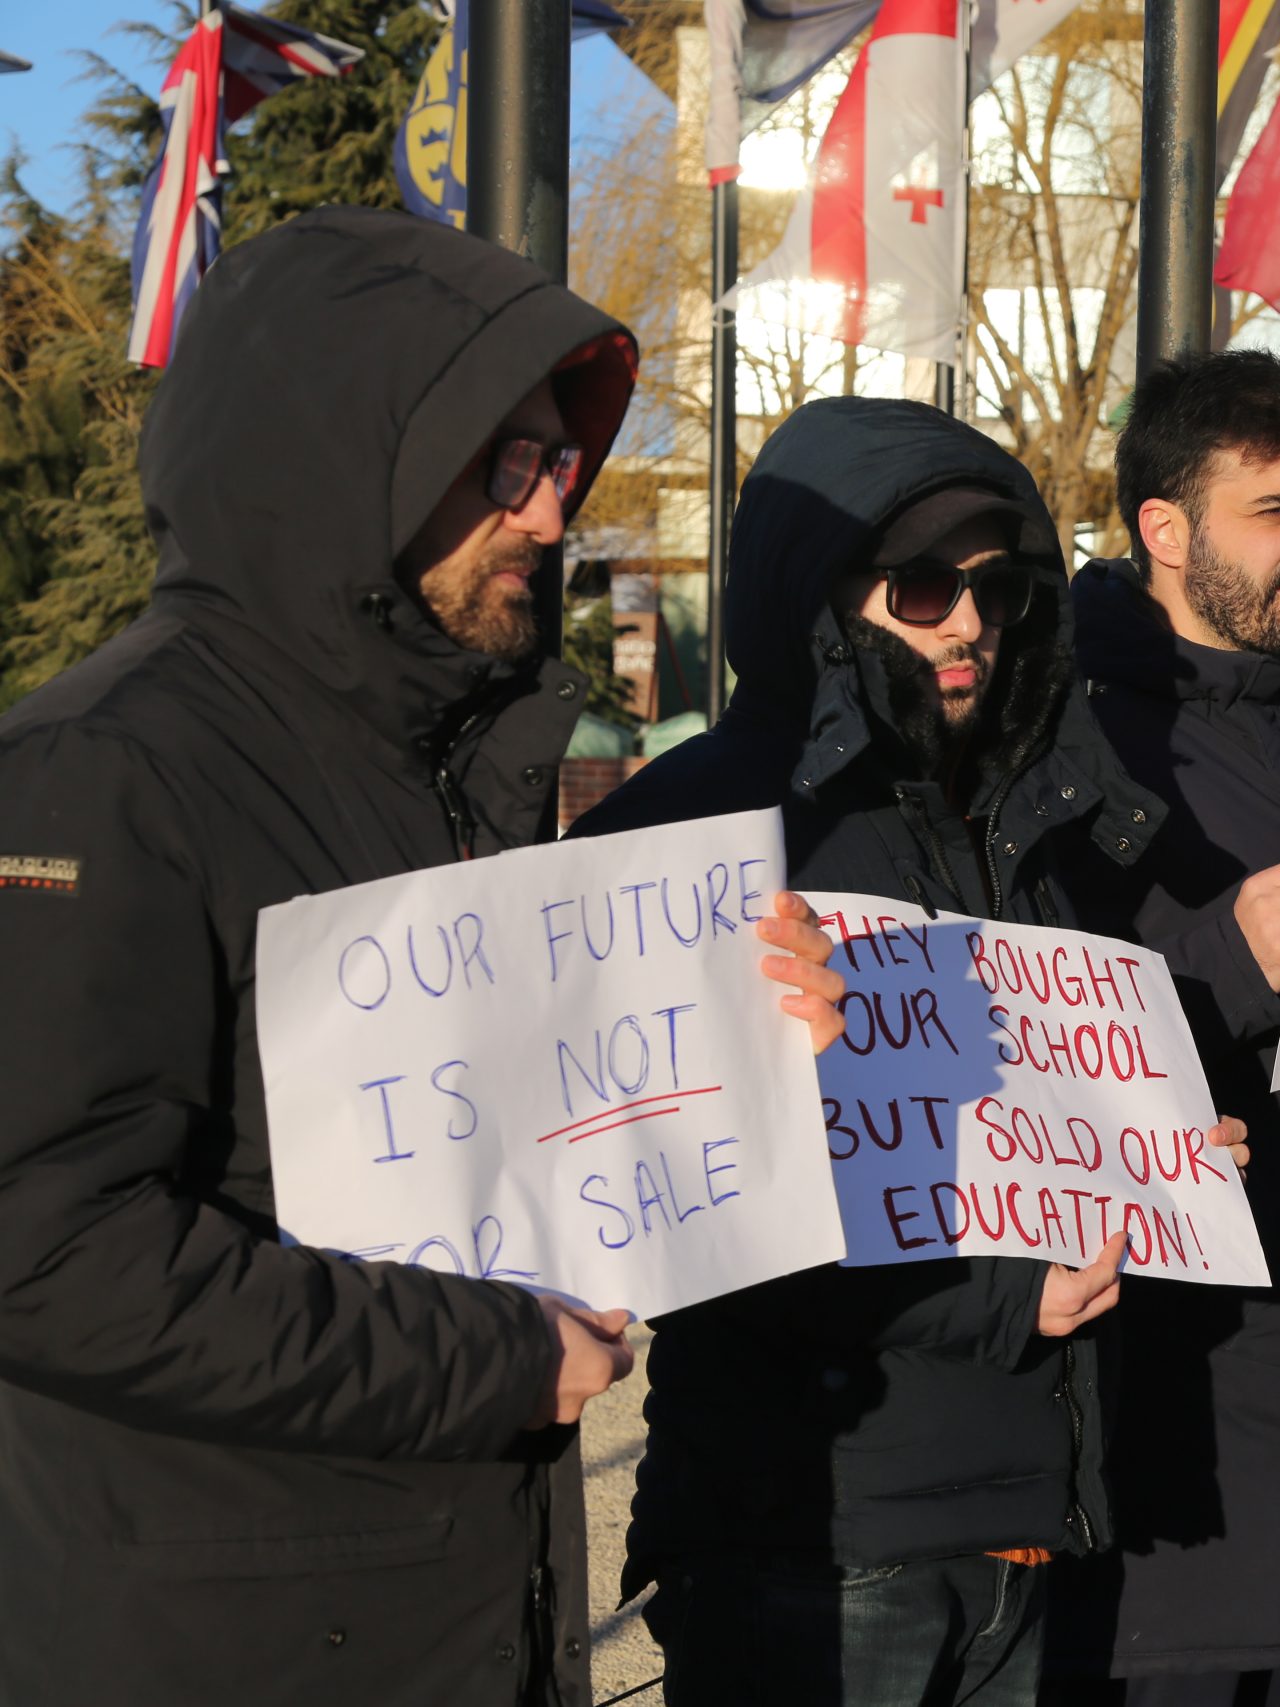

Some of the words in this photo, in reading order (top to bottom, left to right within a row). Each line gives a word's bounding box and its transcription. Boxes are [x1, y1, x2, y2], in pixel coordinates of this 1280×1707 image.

[338, 912, 495, 1009] OUR
[540, 859, 767, 982] FUTURE
[965, 932, 1147, 1012] BOUGHT
[840, 988, 959, 1056] OUR
[987, 1004, 1168, 1082] SCHOOL
[360, 1060, 479, 1164] IS
[556, 1003, 697, 1118] NOT
[823, 1096, 949, 1160] BUT
[974, 1096, 1103, 1172] SOLD
[1119, 1126, 1228, 1185] OUR
[340, 1215, 540, 1281] OR
[579, 1136, 740, 1249] SALE
[883, 1181, 1210, 1271] EDUCATION!
